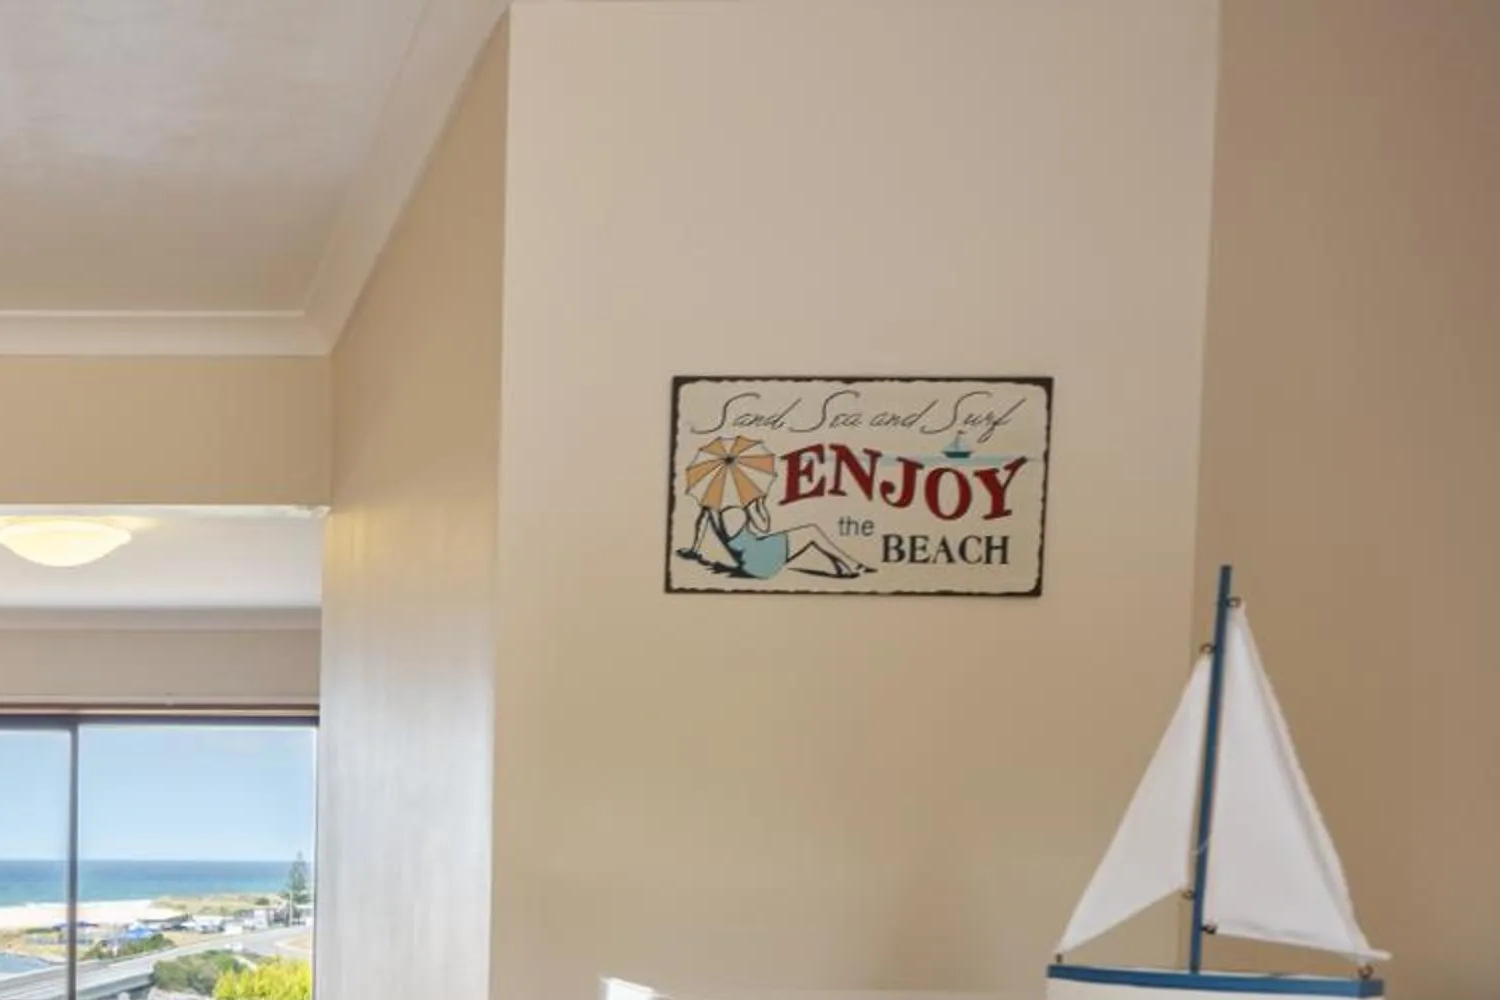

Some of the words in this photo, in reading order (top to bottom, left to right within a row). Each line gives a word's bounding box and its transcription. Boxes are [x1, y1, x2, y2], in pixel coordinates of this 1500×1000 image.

[788, 389, 862, 433] Sea
[870, 398, 938, 428] and
[920, 390, 1027, 444] Surf
[779, 443, 1028, 521] ENJOY
[838, 516, 875, 537] the
[881, 535, 1010, 564] BEACH
